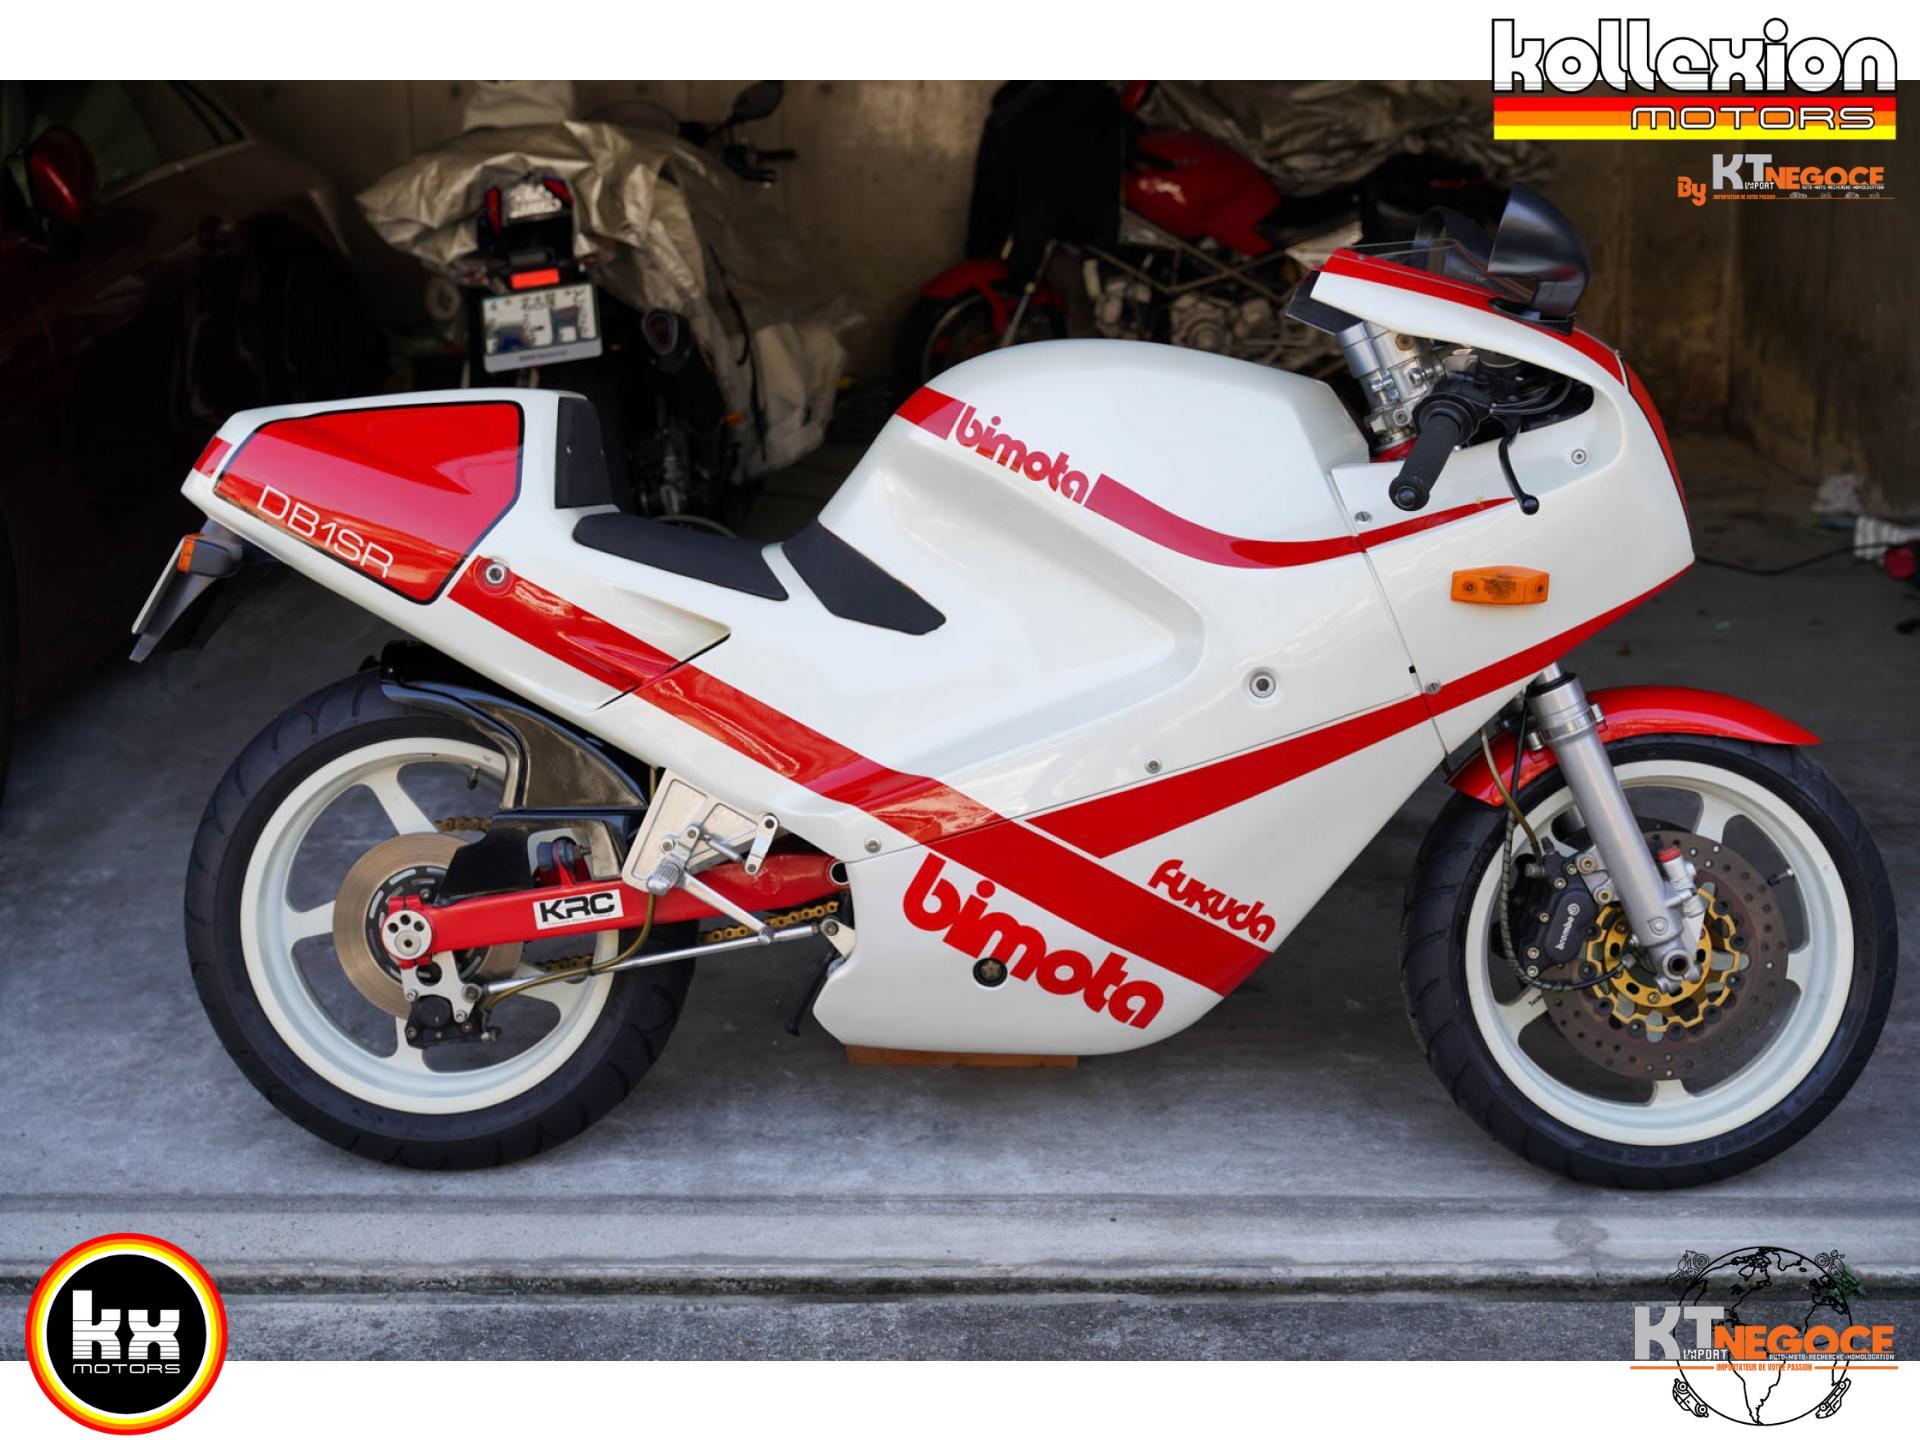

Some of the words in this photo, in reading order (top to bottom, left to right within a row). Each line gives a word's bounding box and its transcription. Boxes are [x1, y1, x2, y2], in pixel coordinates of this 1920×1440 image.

[955, 404, 1089, 505] bimota
[257, 484, 394, 579] DB1SR
[540, 892, 615, 923] KRC
[902, 852, 1164, 1030] bimota
